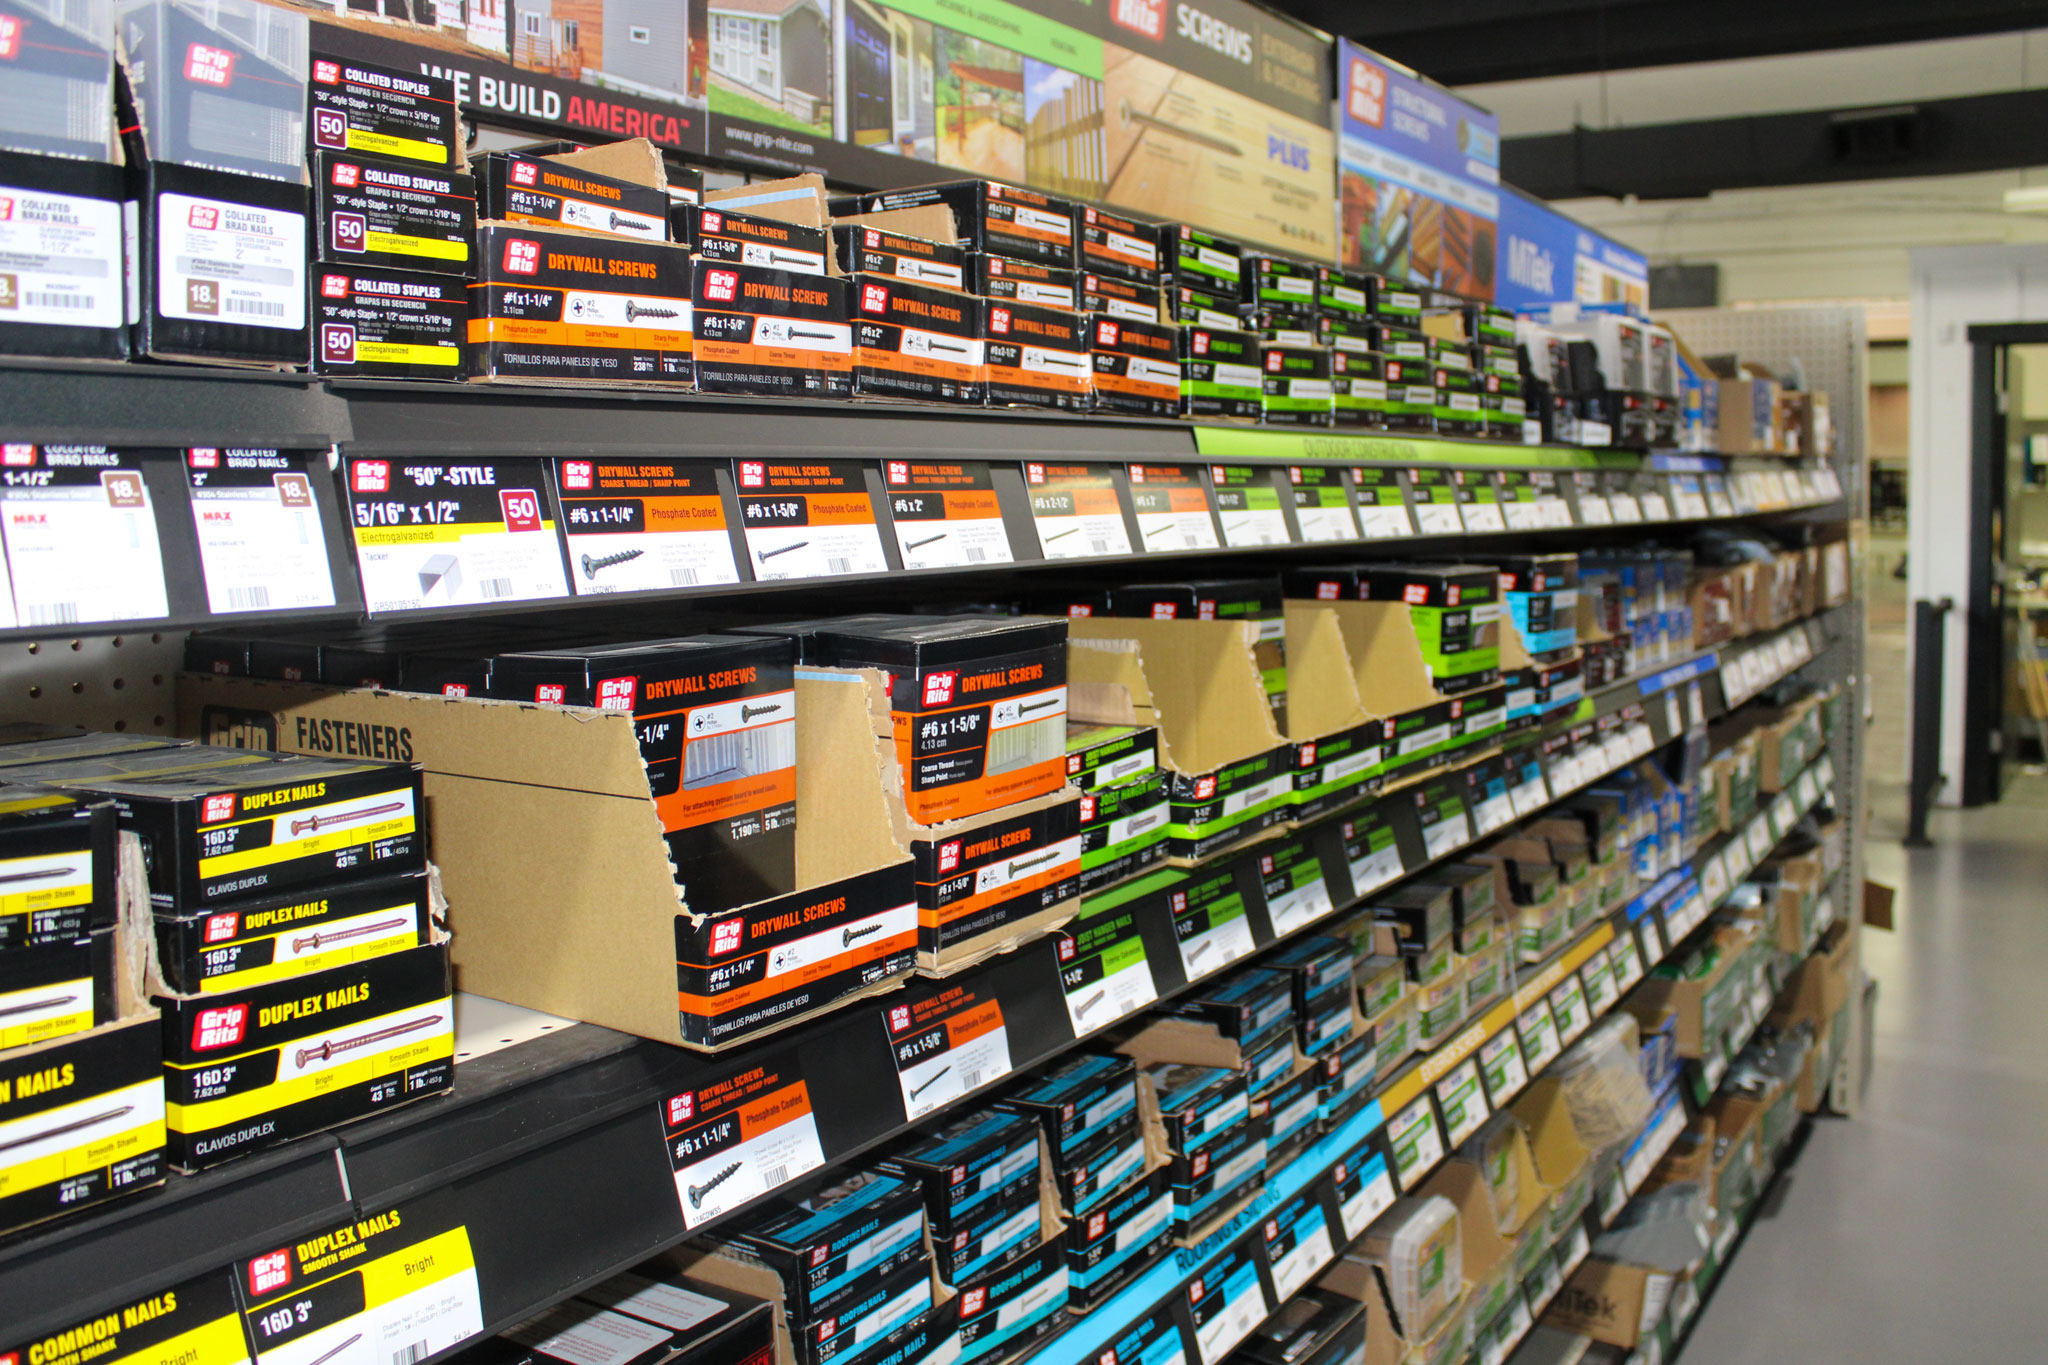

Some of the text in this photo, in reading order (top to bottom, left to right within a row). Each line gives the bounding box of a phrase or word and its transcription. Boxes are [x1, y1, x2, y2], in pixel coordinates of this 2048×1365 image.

[1177, 3, 1252, 64] SCREWS
[192, 46, 230, 69] Grip
[190, 63, 225, 84] Rite
[316, 62, 337, 73] Grip
[317, 71, 336, 82] Rite
[345, 67, 430, 97] COLLATED STAPLES
[346, 84, 416, 106] GRAPAS EN SECUENCIA
[479, 75, 561, 121] BUILD
[348, 97, 369, 110] Staple
[389, 106, 409, 118] crown
[431, 113, 440, 125] leg
[320, 116, 343, 135] 50
[351, 131, 399, 148] Electrogalvanized
[725, 126, 814, 155] www.grip-rite.com
[1268, 134, 1310, 172] PLUS
[364, 169, 450, 193] COLLATED STAPLES
[544, 172, 622, 200] DRYWALL SCREWS
[225, 210, 267, 224] COLLATED
[225, 220, 274, 236] BRAD NAILS
[548, 252, 657, 279] DRYWALL SCREWS
[710, 271, 734, 287] Grip
[354, 279, 441, 299] COLLATED STAPLES
[708, 285, 732, 299] Rite
[744, 282, 828, 306] DRYWALL SCREWS
[892, 297, 961, 323] DRYWALL SCREWS
[703, 317, 717, 328] #6
[503, 353, 618, 368] TORNILLOS PARA PANELES DE YESO
[46, 454, 119, 466] BRAD NAILS
[228, 457, 289, 469] BRAD NAILS
[566, 463, 590, 476] Grip
[356, 462, 386, 478] Grip
[598, 466, 674, 478] DRYWALL SCREWS
[768, 466, 831, 477] DRYWALL SCREWS
[109, 480, 133, 498] 18
[357, 476, 385, 490] Rite
[567, 475, 589, 487] Rite
[600, 479, 690, 488] COARSE THREAD SHARP POINT
[410, 507, 422, 523] x
[508, 498, 535, 519] 50
[570, 507, 589, 524] #6
[592, 511, 599, 523] x
[652, 507, 717, 520] Phosphate Coated
[746, 503, 762, 518] #6
[764, 506, 771, 518] x
[894, 499, 908, 513] #6
[909, 502, 915, 512] x
[13, 513, 48, 525] MAX
[361, 531, 435, 544] Electrogalvanized
[365, 552, 389, 561] Tacker
[645, 666, 757, 700] DRYWALL SCREWS
[927, 674, 953, 689] Grip
[962, 664, 1044, 693] DRYWALL SCREWS
[602, 681, 632, 697] Grip
[926, 688, 950, 704] Rite
[601, 696, 629, 710] Rite
[921, 721, 938, 738] #6
[941, 722, 948, 735] x
[296, 717, 413, 762] FASTENERS
[921, 738, 947, 750] 4.13 cm
[921, 760, 955, 774] Coarse Thread
[921, 772, 949, 786] Sharp Point
[242, 782, 326, 811] DUPLEX NAILS
[731, 823, 752, 840] 1,190
[765, 820, 771, 831] 5
[965, 828, 1031, 860] DRYWALL SCREWS
[245, 900, 328, 930] DUPLEX NAILS
[751, 897, 846, 939] DRYWALL SCREWS
[715, 921, 740, 940] Grip
[714, 937, 739, 955] Rite
[710, 969, 724, 984] #6
[259, 982, 370, 1028] DUPLEX NAILS
[202, 1008, 242, 1028] Grip
[200, 1026, 239, 1047] Rite
[389, 1045, 429, 1063] Smooth Shank
[17, 1063, 75, 1099] NAILS
[193, 1069, 222, 1088] 16D
[698, 1067, 765, 1103] DRYWALL SCREWS
[671, 1094, 692, 1111] Grip
[746, 1094, 803, 1126] Phosphate Coated
[672, 1107, 692, 1123] Rite
[196, 1121, 275, 1155] CLAVOS DUPLEX
[676, 1139, 693, 1158] #6
[694, 1139, 702, 1151] x
[296, 1210, 401, 1263] DUPLEX NAILS
[832, 1218, 879, 1253] ROOFING NAILS
[302, 1242, 367, 1275] SMOOTH SHANK
[1176, 1226, 1233, 1275] ROOFING
[253, 1253, 286, 1276] Grip
[404, 1255, 435, 1276] Bright
[256, 1270, 286, 1292] Rite
[990, 1260, 1042, 1299] ROOFING NAILS
[29, 1292, 177, 1365] COMMON NAILS
[260, 1312, 293, 1336] 16D
